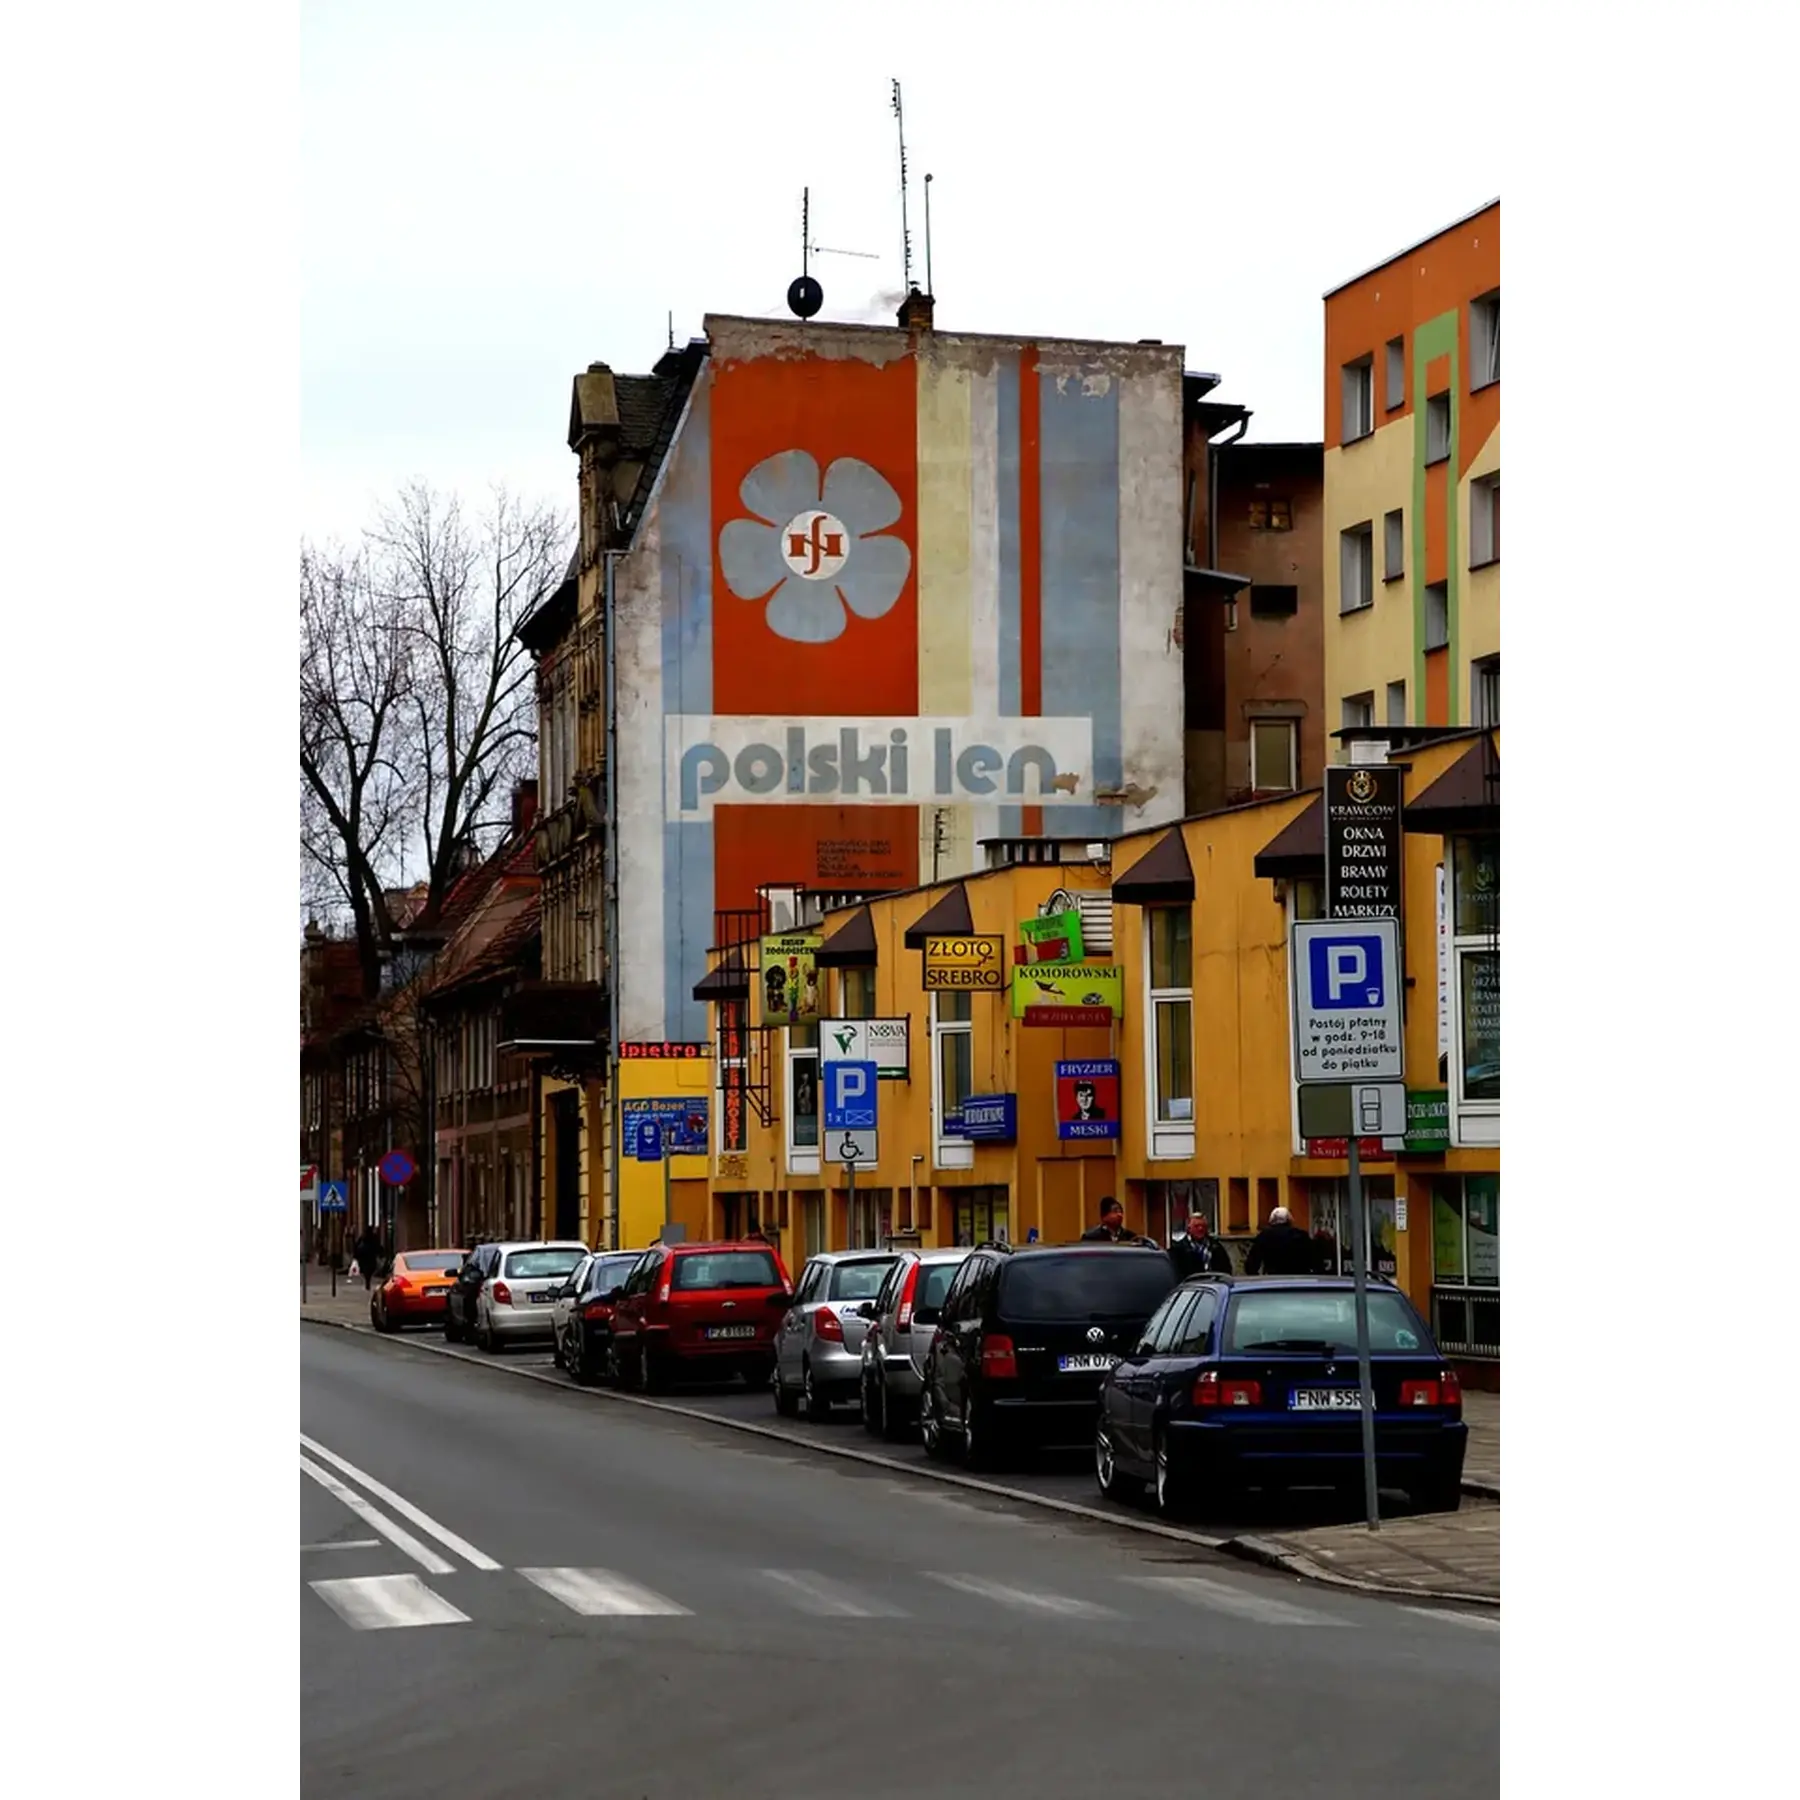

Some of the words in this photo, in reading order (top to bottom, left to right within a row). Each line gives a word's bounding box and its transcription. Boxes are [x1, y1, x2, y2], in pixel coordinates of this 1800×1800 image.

[680, 727, 908, 810] polski
[935, 728, 1058, 794] len
[1342, 826, 1385, 841] OKNA
[1341, 844, 1387, 858] DRZWI
[1340, 865, 1388, 878] BRAMY
[1339, 885, 1389, 899] ROLETY
[1332, 904, 1397, 917] MARKIZY
[928, 940, 993, 958] ZŁOTO
[927, 969, 1001, 985] SREBRO
[1019, 967, 1118, 979] KOMOROWSKI
[1327, 944, 1367, 1000] P
[1309, 1018, 1345, 1030] Postój
[1349, 1016, 1388, 1029] płatny
[1311, 1034, 1321, 1042] w
[1325, 1031, 1357, 1044] godz.
[1360, 1030, 1386, 1041] 9-18
[1303, 1046, 1318, 1057] od
[1060, 1063, 1114, 1076] FRYZJER
[1322, 1060, 1338, 1070] do
[836, 1067, 867, 1109] P
[1066, 1354, 1090, 1367] FNW
[1297, 1390, 1330, 1405] FNW
